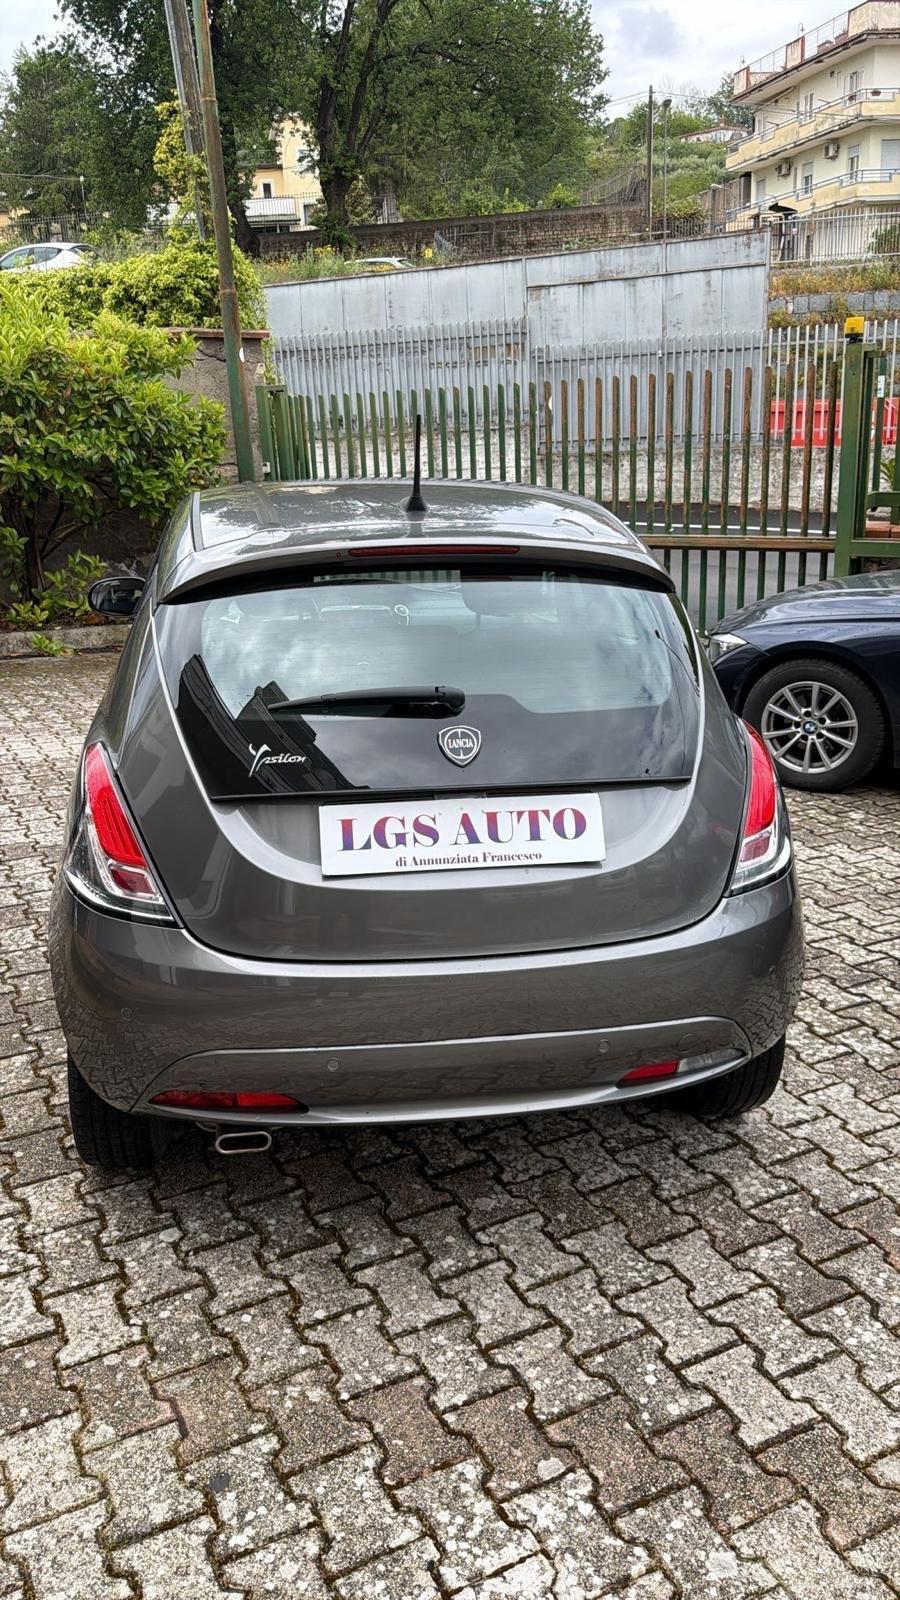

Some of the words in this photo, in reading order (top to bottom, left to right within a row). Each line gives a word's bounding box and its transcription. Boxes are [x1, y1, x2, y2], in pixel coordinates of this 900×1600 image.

[448, 738, 474, 749] LANCIA
[248, 743, 306, 778] Ypsilon
[336, 814, 440, 852] LGS
[449, 807, 587, 846] AUTO
[395, 857, 407, 868] di
[410, 853, 479, 867] Annunziata
[482, 851, 542, 863] Francesco
